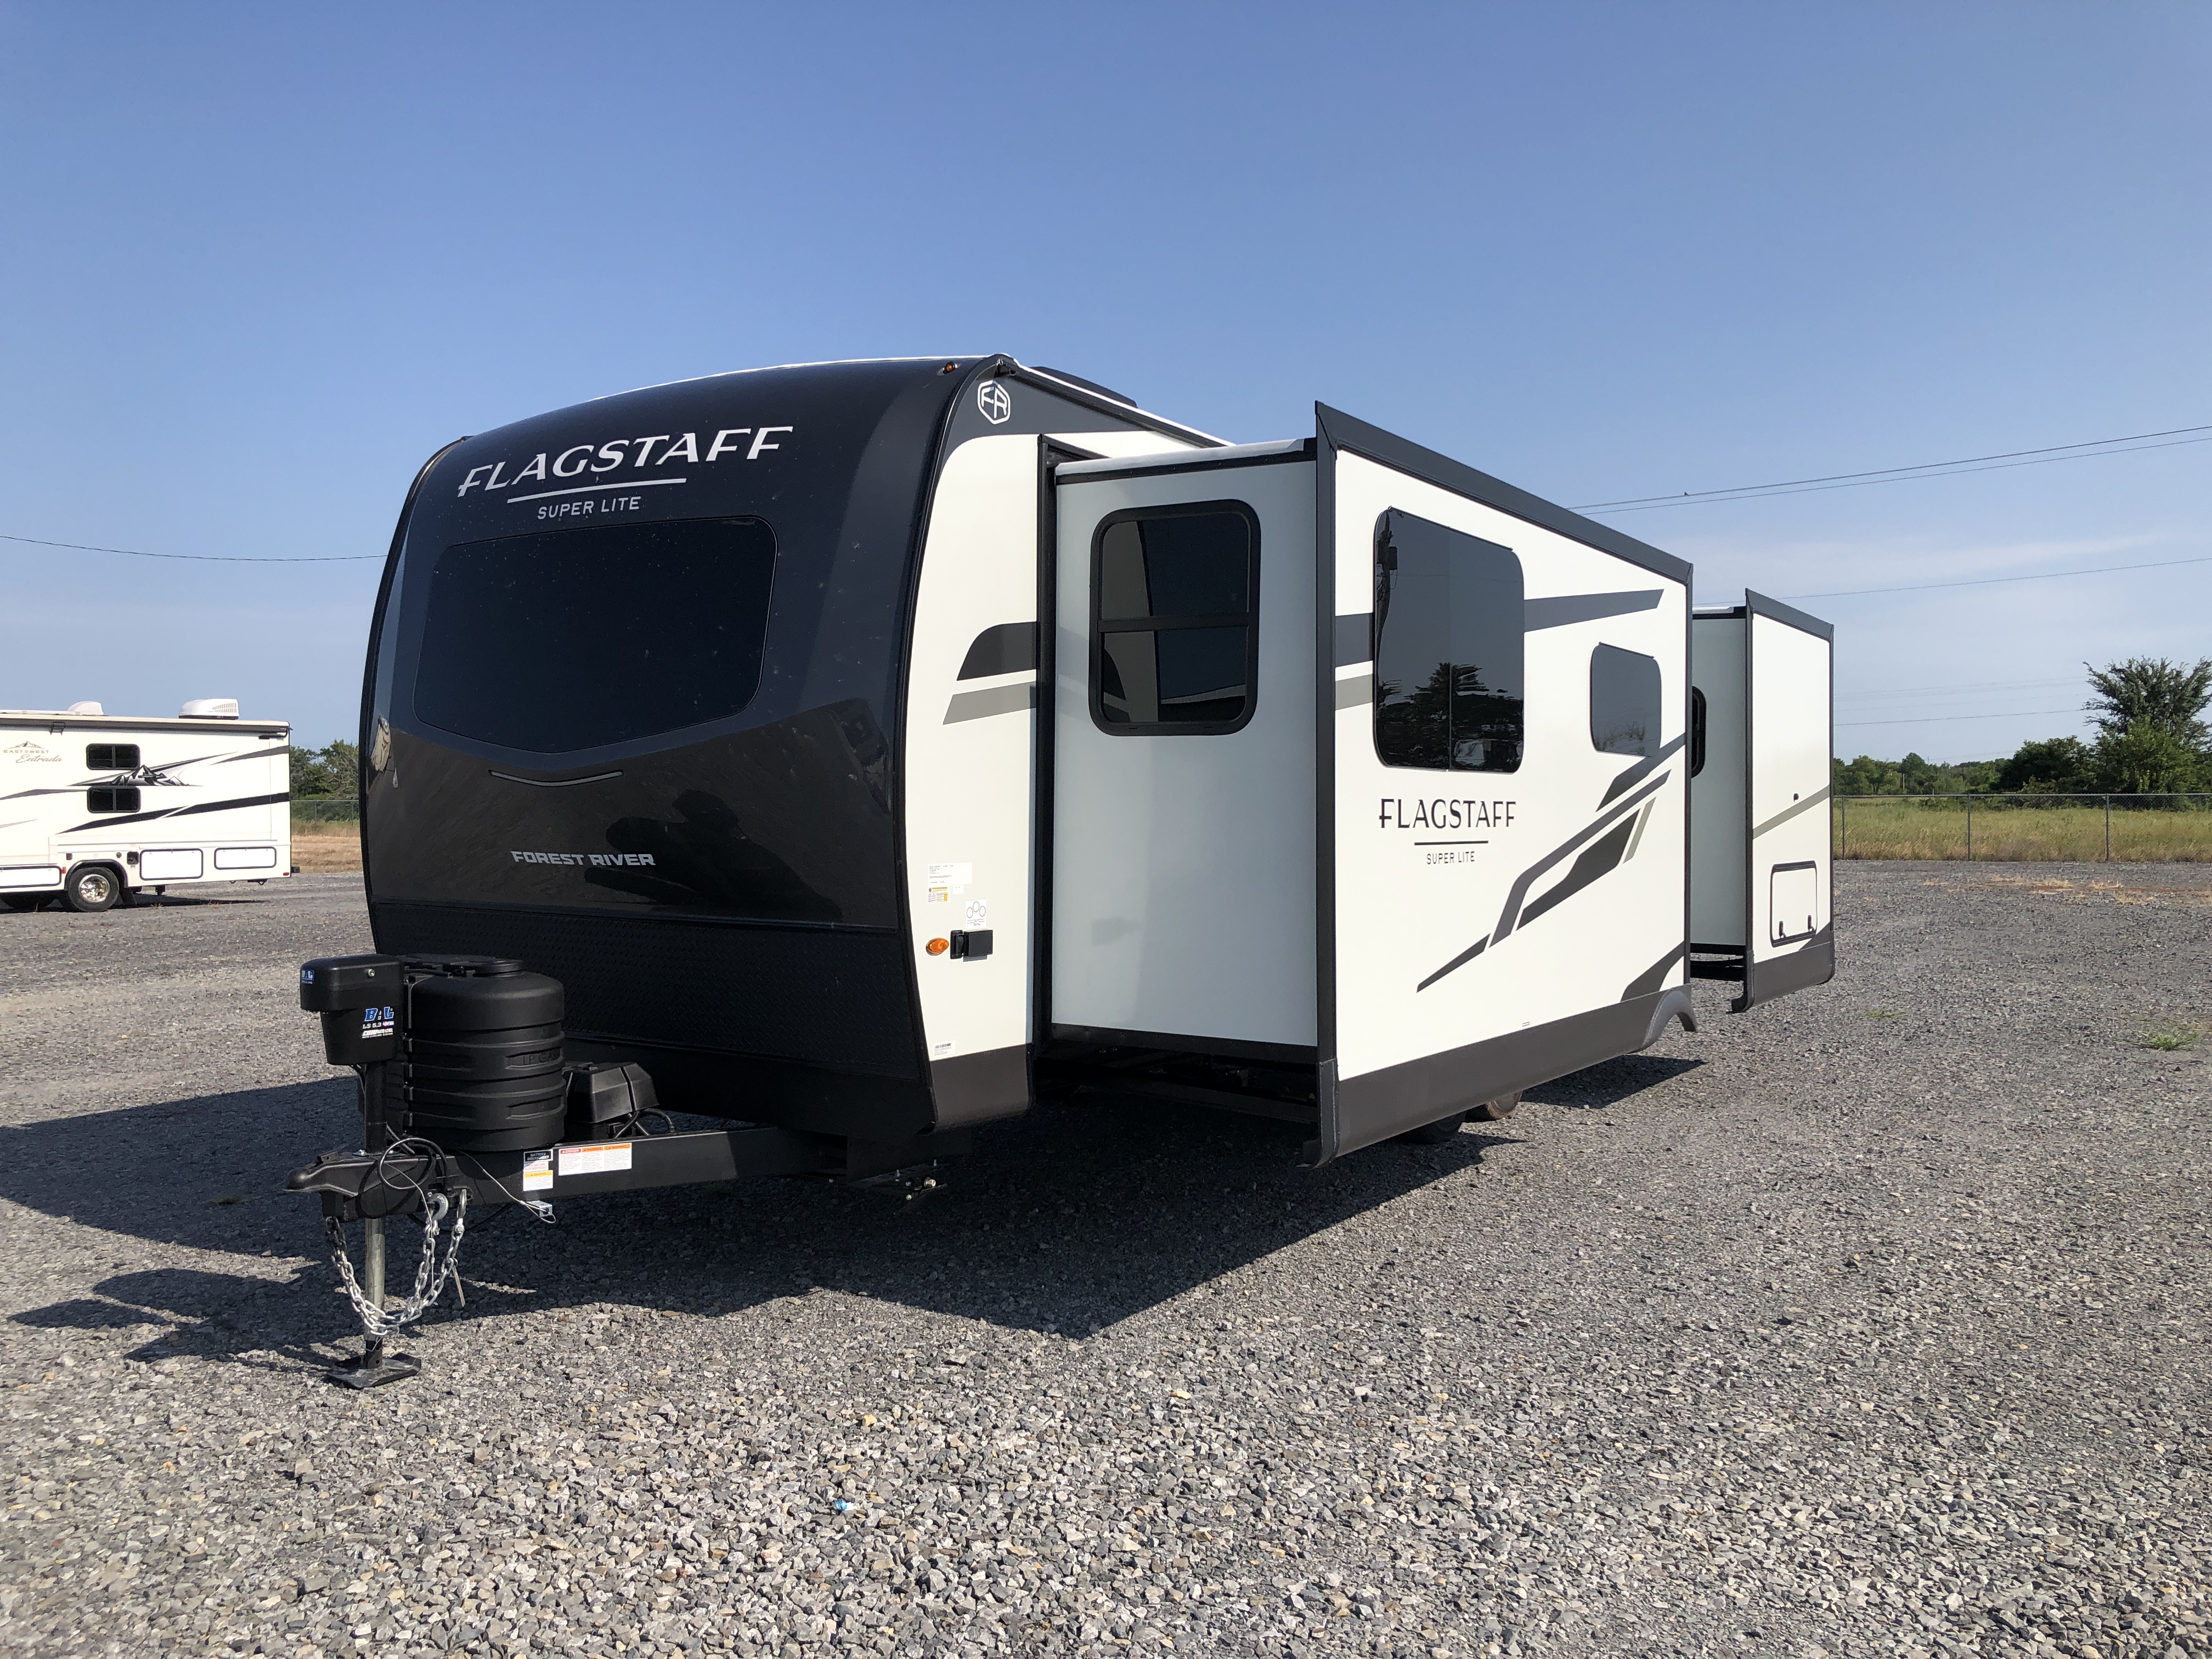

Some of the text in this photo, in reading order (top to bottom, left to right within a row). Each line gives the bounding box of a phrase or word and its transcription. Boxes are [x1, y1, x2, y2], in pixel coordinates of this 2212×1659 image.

[458, 426, 793, 497] FLAGSTAFF
[537, 496, 641, 520] SUPER LITE
[15, 754, 63, 763] Entrada
[1379, 798, 1517, 829] FLAGSTAFF
[510, 851, 656, 866] FOREST RIVER
[1426, 851, 1475, 865] SUPER LITE
